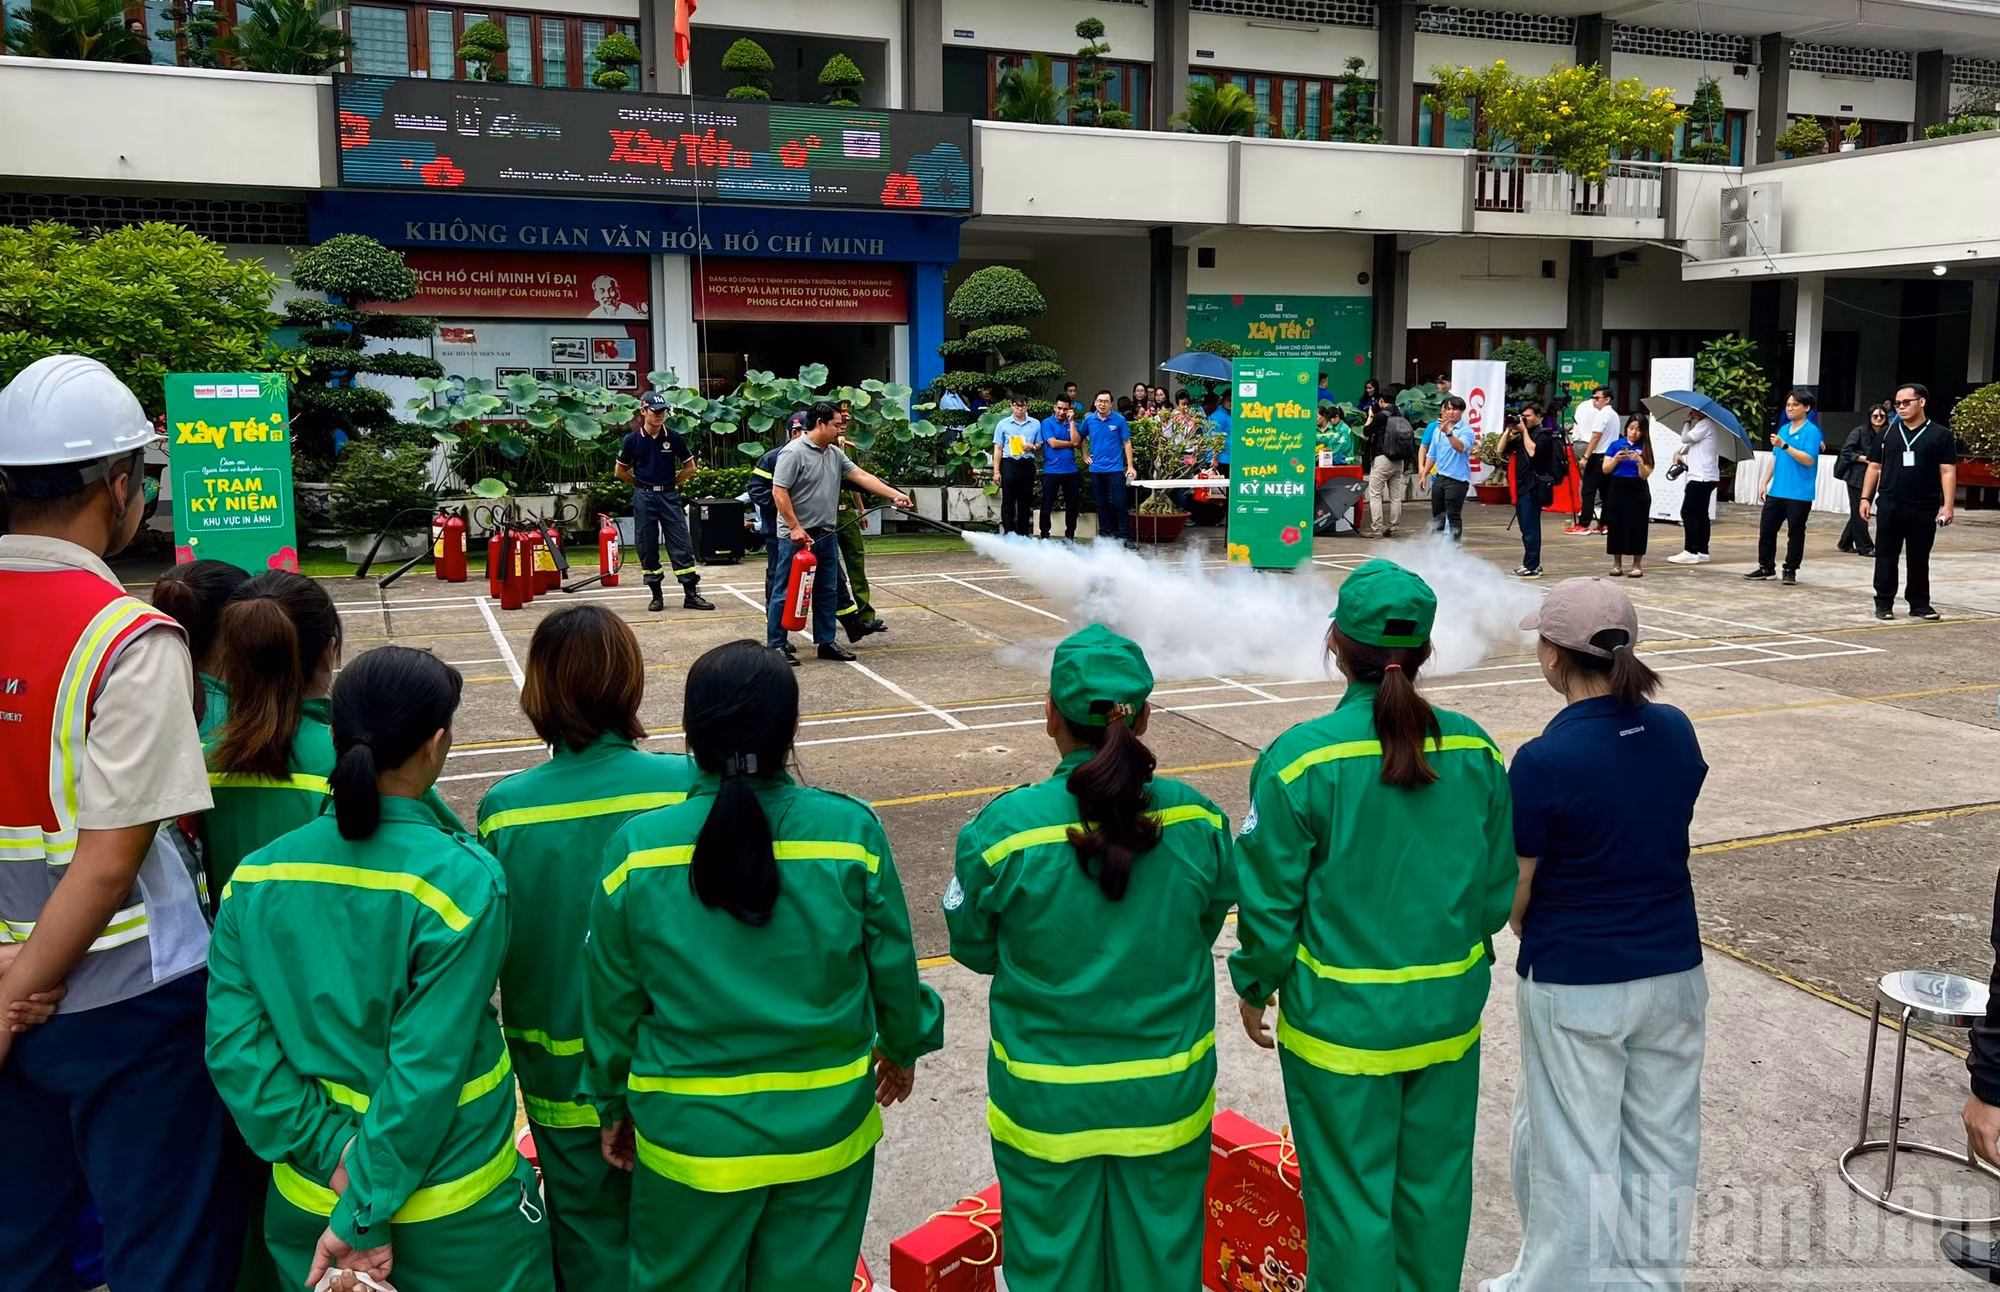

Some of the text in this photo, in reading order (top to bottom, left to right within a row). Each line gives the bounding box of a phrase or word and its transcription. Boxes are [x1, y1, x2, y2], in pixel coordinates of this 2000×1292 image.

[609, 128, 733, 171] Xây Tết
[405, 218, 884, 255] KHÔNG GIAN VĂN HÓA HỒ CHÍ MINH
[471, 270, 494, 283] CHÍ
[497, 272, 534, 284] MINH
[537, 271, 550, 284] VĨ
[553, 274, 577, 288] ĐẠI
[426, 287, 457, 296] TRONG
[459, 287, 471, 297] SỰ
[474, 287, 507, 298] NGHIỆP
[509, 287, 527, 297] CỦA
[529, 288, 561, 298] CHÚNG
[562, 289, 573, 298] TA
[709, 285, 729, 296] HỌC
[729, 284, 746, 296] TẬP
[747, 284, 759, 294] VÀ
[761, 284, 780, 295] LÀM
[781, 287, 803, 296] THEO
[805, 287, 817, 296] TƯ
[852, 288, 871, 299] ĐẠO
[747, 298, 779, 306] PHONG
[780, 297, 803, 307] CÁCH
[819, 297, 834, 308] CHÍ
[835, 299, 858, 308] MINH
[1247, 321, 1278, 344] Xây
[1279, 320, 1302, 339] Tết
[1240, 400, 1301, 423] Xây Tết
[176, 417, 269, 449] Xây Tết
[1246, 425, 1263, 434] CẢM
[1242, 464, 1278, 478] TRẠM
[203, 477, 262, 494] TRẠM
[1240, 479, 1304, 498] KỶ NIỆM
[191, 492, 277, 512] KỶ NIỆM
[203, 513, 271, 527] KHU VỰC IN ẢNH
